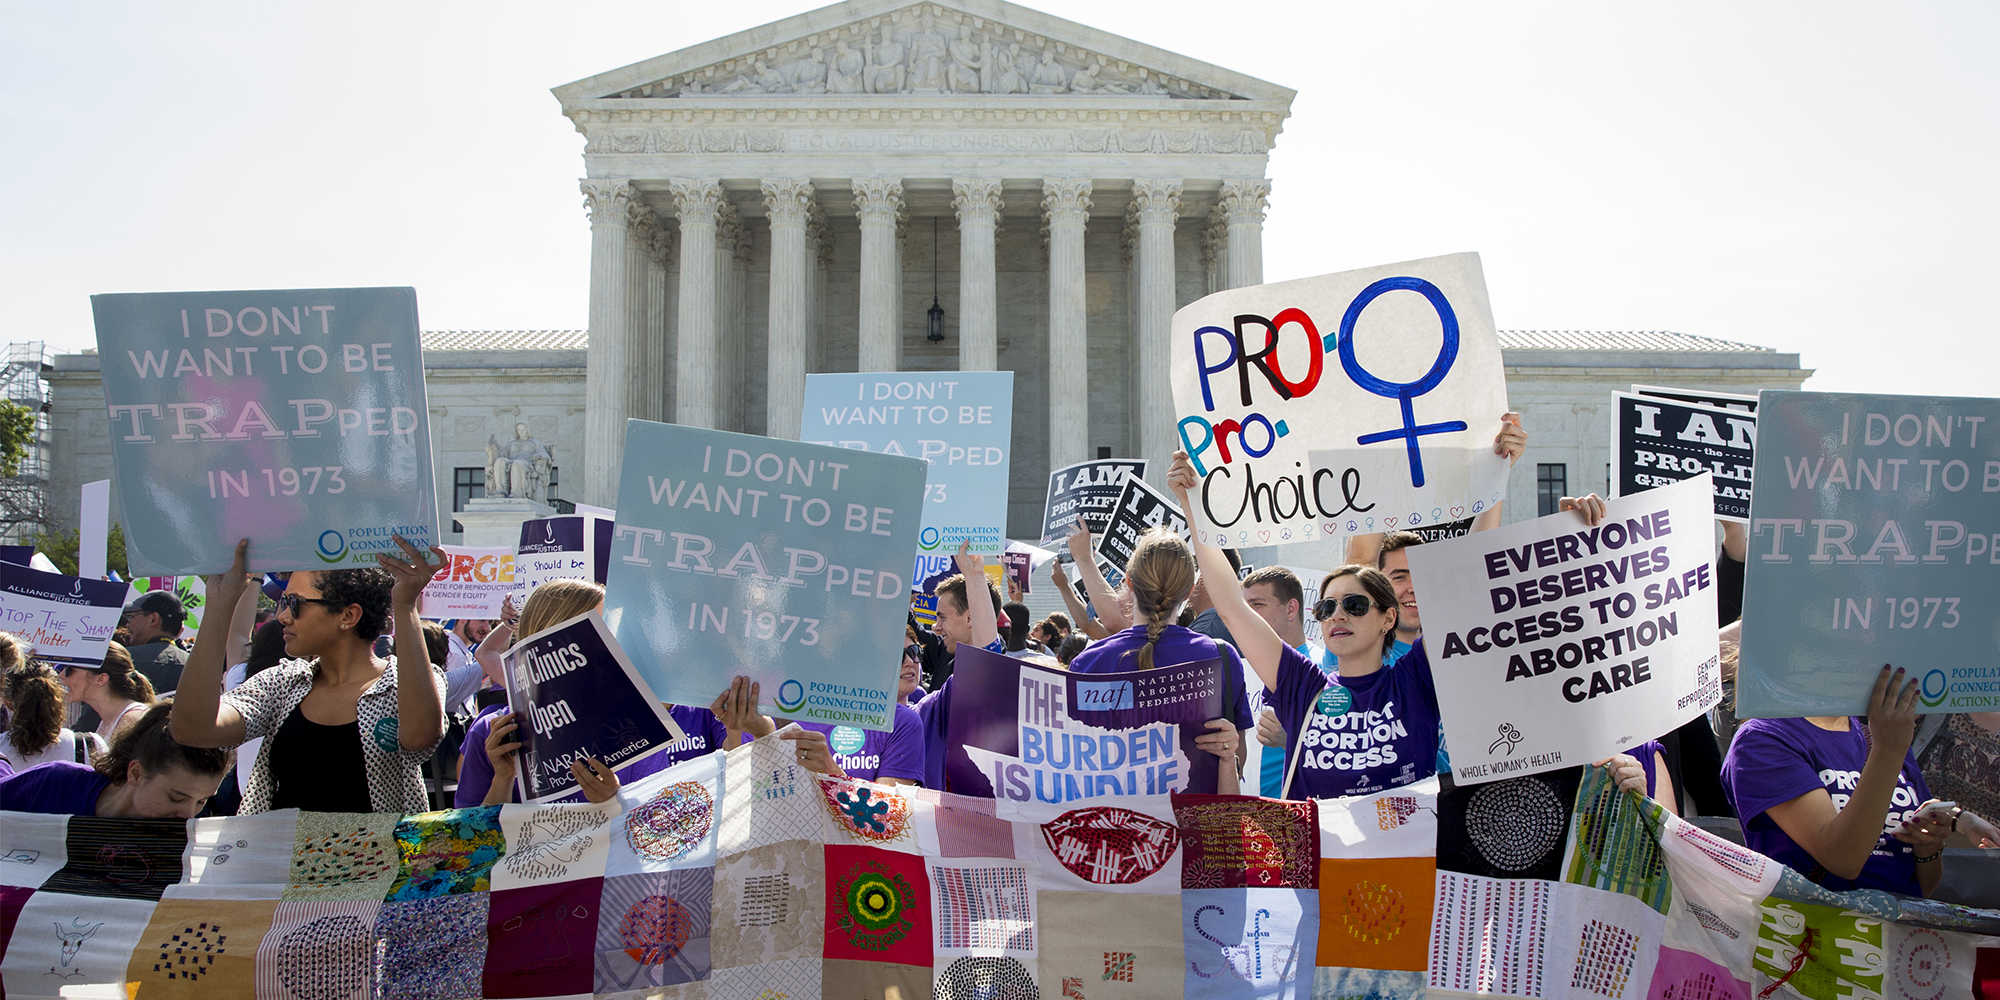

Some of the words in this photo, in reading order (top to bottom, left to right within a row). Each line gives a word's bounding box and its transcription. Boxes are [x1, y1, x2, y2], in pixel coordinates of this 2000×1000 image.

[800, 134, 861, 149] EQUAL
[866, 134, 940, 149] JUSTICE
[950, 134, 1014, 149] UNDER
[1020, 134, 1056, 149] LAW
[180, 309, 190, 338] I
[205, 305, 335, 338] DON'T
[127, 346, 258, 379] WANT
[271, 345, 328, 375] TO
[343, 342, 394, 373] BE
[858, 382, 865, 401] I
[874, 381, 960, 401] DON'T
[821, 406, 905, 425] WANT
[912, 405, 949, 425] TO
[958, 405, 993, 425] BE
[1634, 404, 1662, 437] I
[1842, 412, 1850, 446] I
[1865, 413, 1986, 449] DON'T
[1634, 449, 1754, 482] PRO-LI
[1703, 447, 1723, 457] the
[207, 469, 249, 498] IN
[262, 466, 347, 496] 1973
[703, 445, 712, 473] I
[725, 447, 849, 491] DON'T
[1054, 473, 1068, 496] I
[1069, 465, 1135, 489] AM
[1784, 456, 1908, 491] WANT
[1920, 459, 1970, 493] TO
[1982, 461, 2000, 492] B
[647, 475, 768, 518] WANT
[778, 493, 831, 527] TO
[844, 503, 894, 537] BE
[1125, 486, 1146, 516] I
[1201, 461, 1376, 529] Choice
[348, 525, 428, 537] POPULATION
[349, 538, 430, 551] CONNECION
[941, 535, 999, 543] CONNECTION
[942, 526, 1000, 534] POPULATION
[1484, 508, 1672, 580] EVERYONE
[1754, 518, 2000, 565] TRAPPE
[519, 544, 538, 552] LLIANCE
[941, 544, 973, 552] ACTIN
[975, 544, 999, 552] FUND
[570, 559, 585, 569] be
[912, 554, 949, 586] DUE
[7, 584, 56, 599] ALLIANCE
[1489, 546, 1671, 615] DESERVES
[432, 591, 462, 599] GENDER
[462, 592, 488, 600] EQUITY
[688, 602, 728, 635] IN
[742, 609, 820, 646] 1973
[1441, 605, 1585, 659] ACCESS
[1590, 591, 1637, 625] TO
[1643, 562, 1711, 610] SAFE
[1832, 597, 1873, 630] IN
[1886, 597, 1962, 630] 1973
[1505, 611, 1679, 683] ABORTION
[509, 658, 532, 698] Keep
[526, 640, 588, 685] Clinics
[1138, 667, 1215, 686] NATIONAL
[1562, 656, 1652, 703] CARE
[1697, 654, 1718, 676] CENTER
[809, 681, 889, 700] POPULATION
[1138, 678, 1215, 697] ABORTION
[1677, 676, 1719, 710] REPRODUCTIVE
[1698, 672, 1709, 688] FOR
[807, 694, 887, 713] CONNECTION
[1022, 677, 1064, 730] THE
[1084, 679, 1128, 711] naf
[1139, 688, 1215, 708] FEDERATION
[1699, 688, 1720, 710] RIGHTS
[1949, 696, 1991, 708] ACTION
[528, 699, 577, 740] Open
[806, 707, 852, 723] ACTION
[853, 713, 885, 726] FUND
[541, 746, 597, 775] NARAL
[603, 738, 650, 765] America
[832, 750, 880, 770] Choice
[1022, 726, 1175, 771] BURDEN
[1303, 745, 1398, 771] ACCESS
[1459, 765, 1488, 779] WHOLE
[1490, 758, 1529, 774] WOMAN'S
[1531, 751, 1563, 768] HEALTH
[995, 761, 1030, 801] IS
[867, 860, 891, 874] THE
